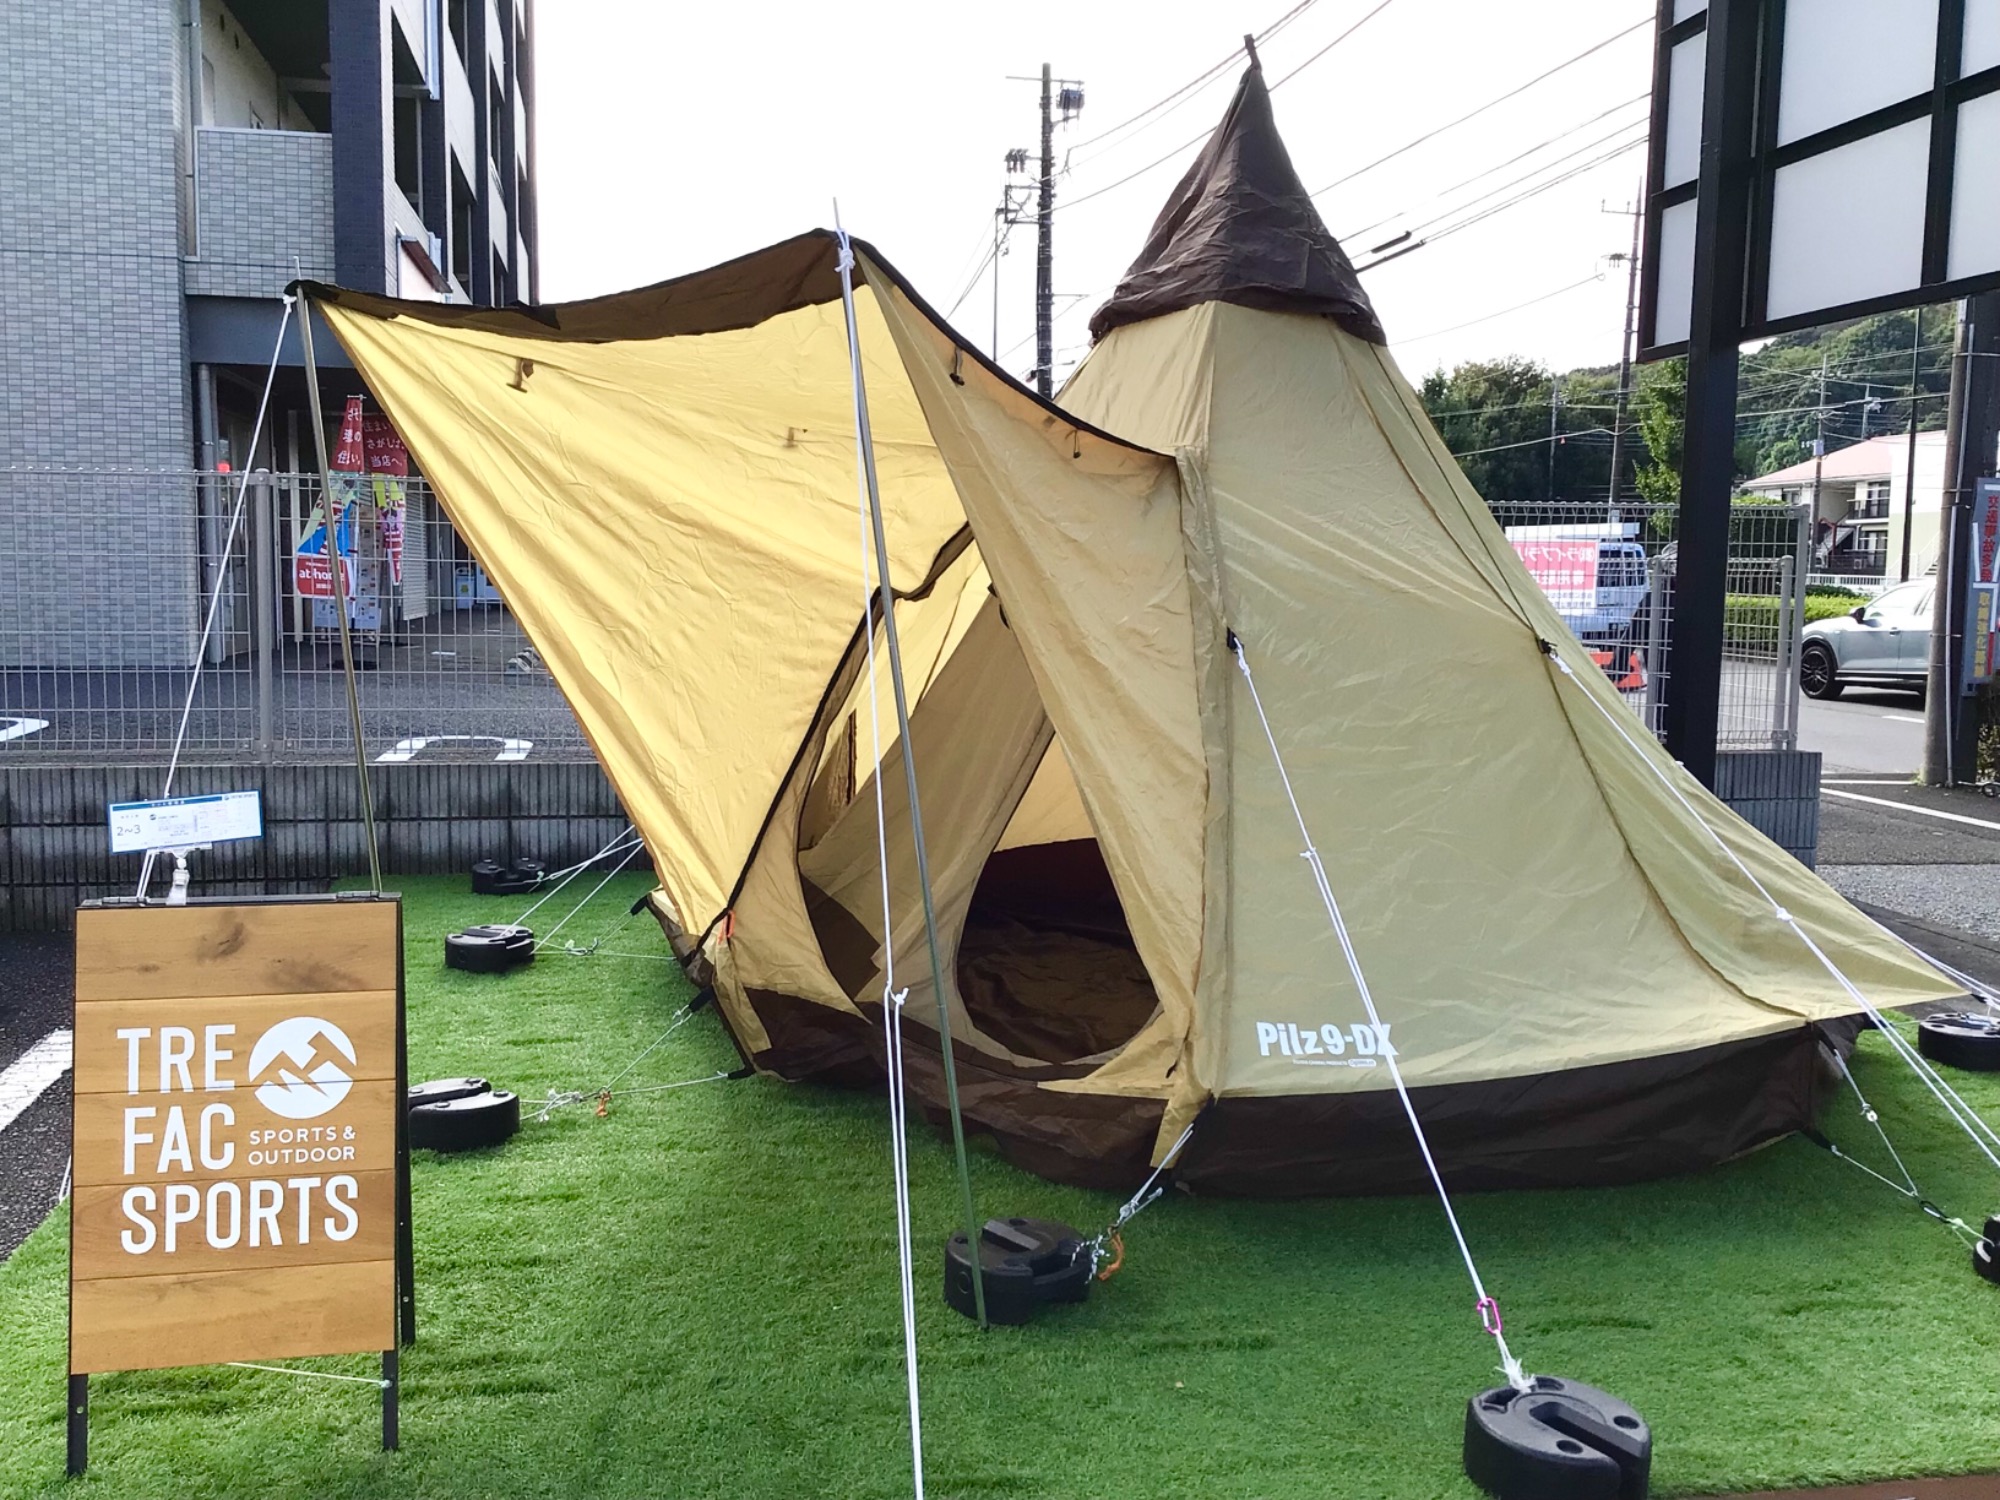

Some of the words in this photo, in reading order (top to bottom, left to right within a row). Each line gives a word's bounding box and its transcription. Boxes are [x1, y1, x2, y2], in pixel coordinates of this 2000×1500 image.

[116, 1023, 236, 1096] TRE
[122, 1102, 236, 1176] FAC
[248, 1146, 356, 1166] OUTDOOR
[249, 1126, 338, 1146] SPORTS
[342, 1125, 356, 1141] &
[120, 1174, 359, 1255] SPORTS
